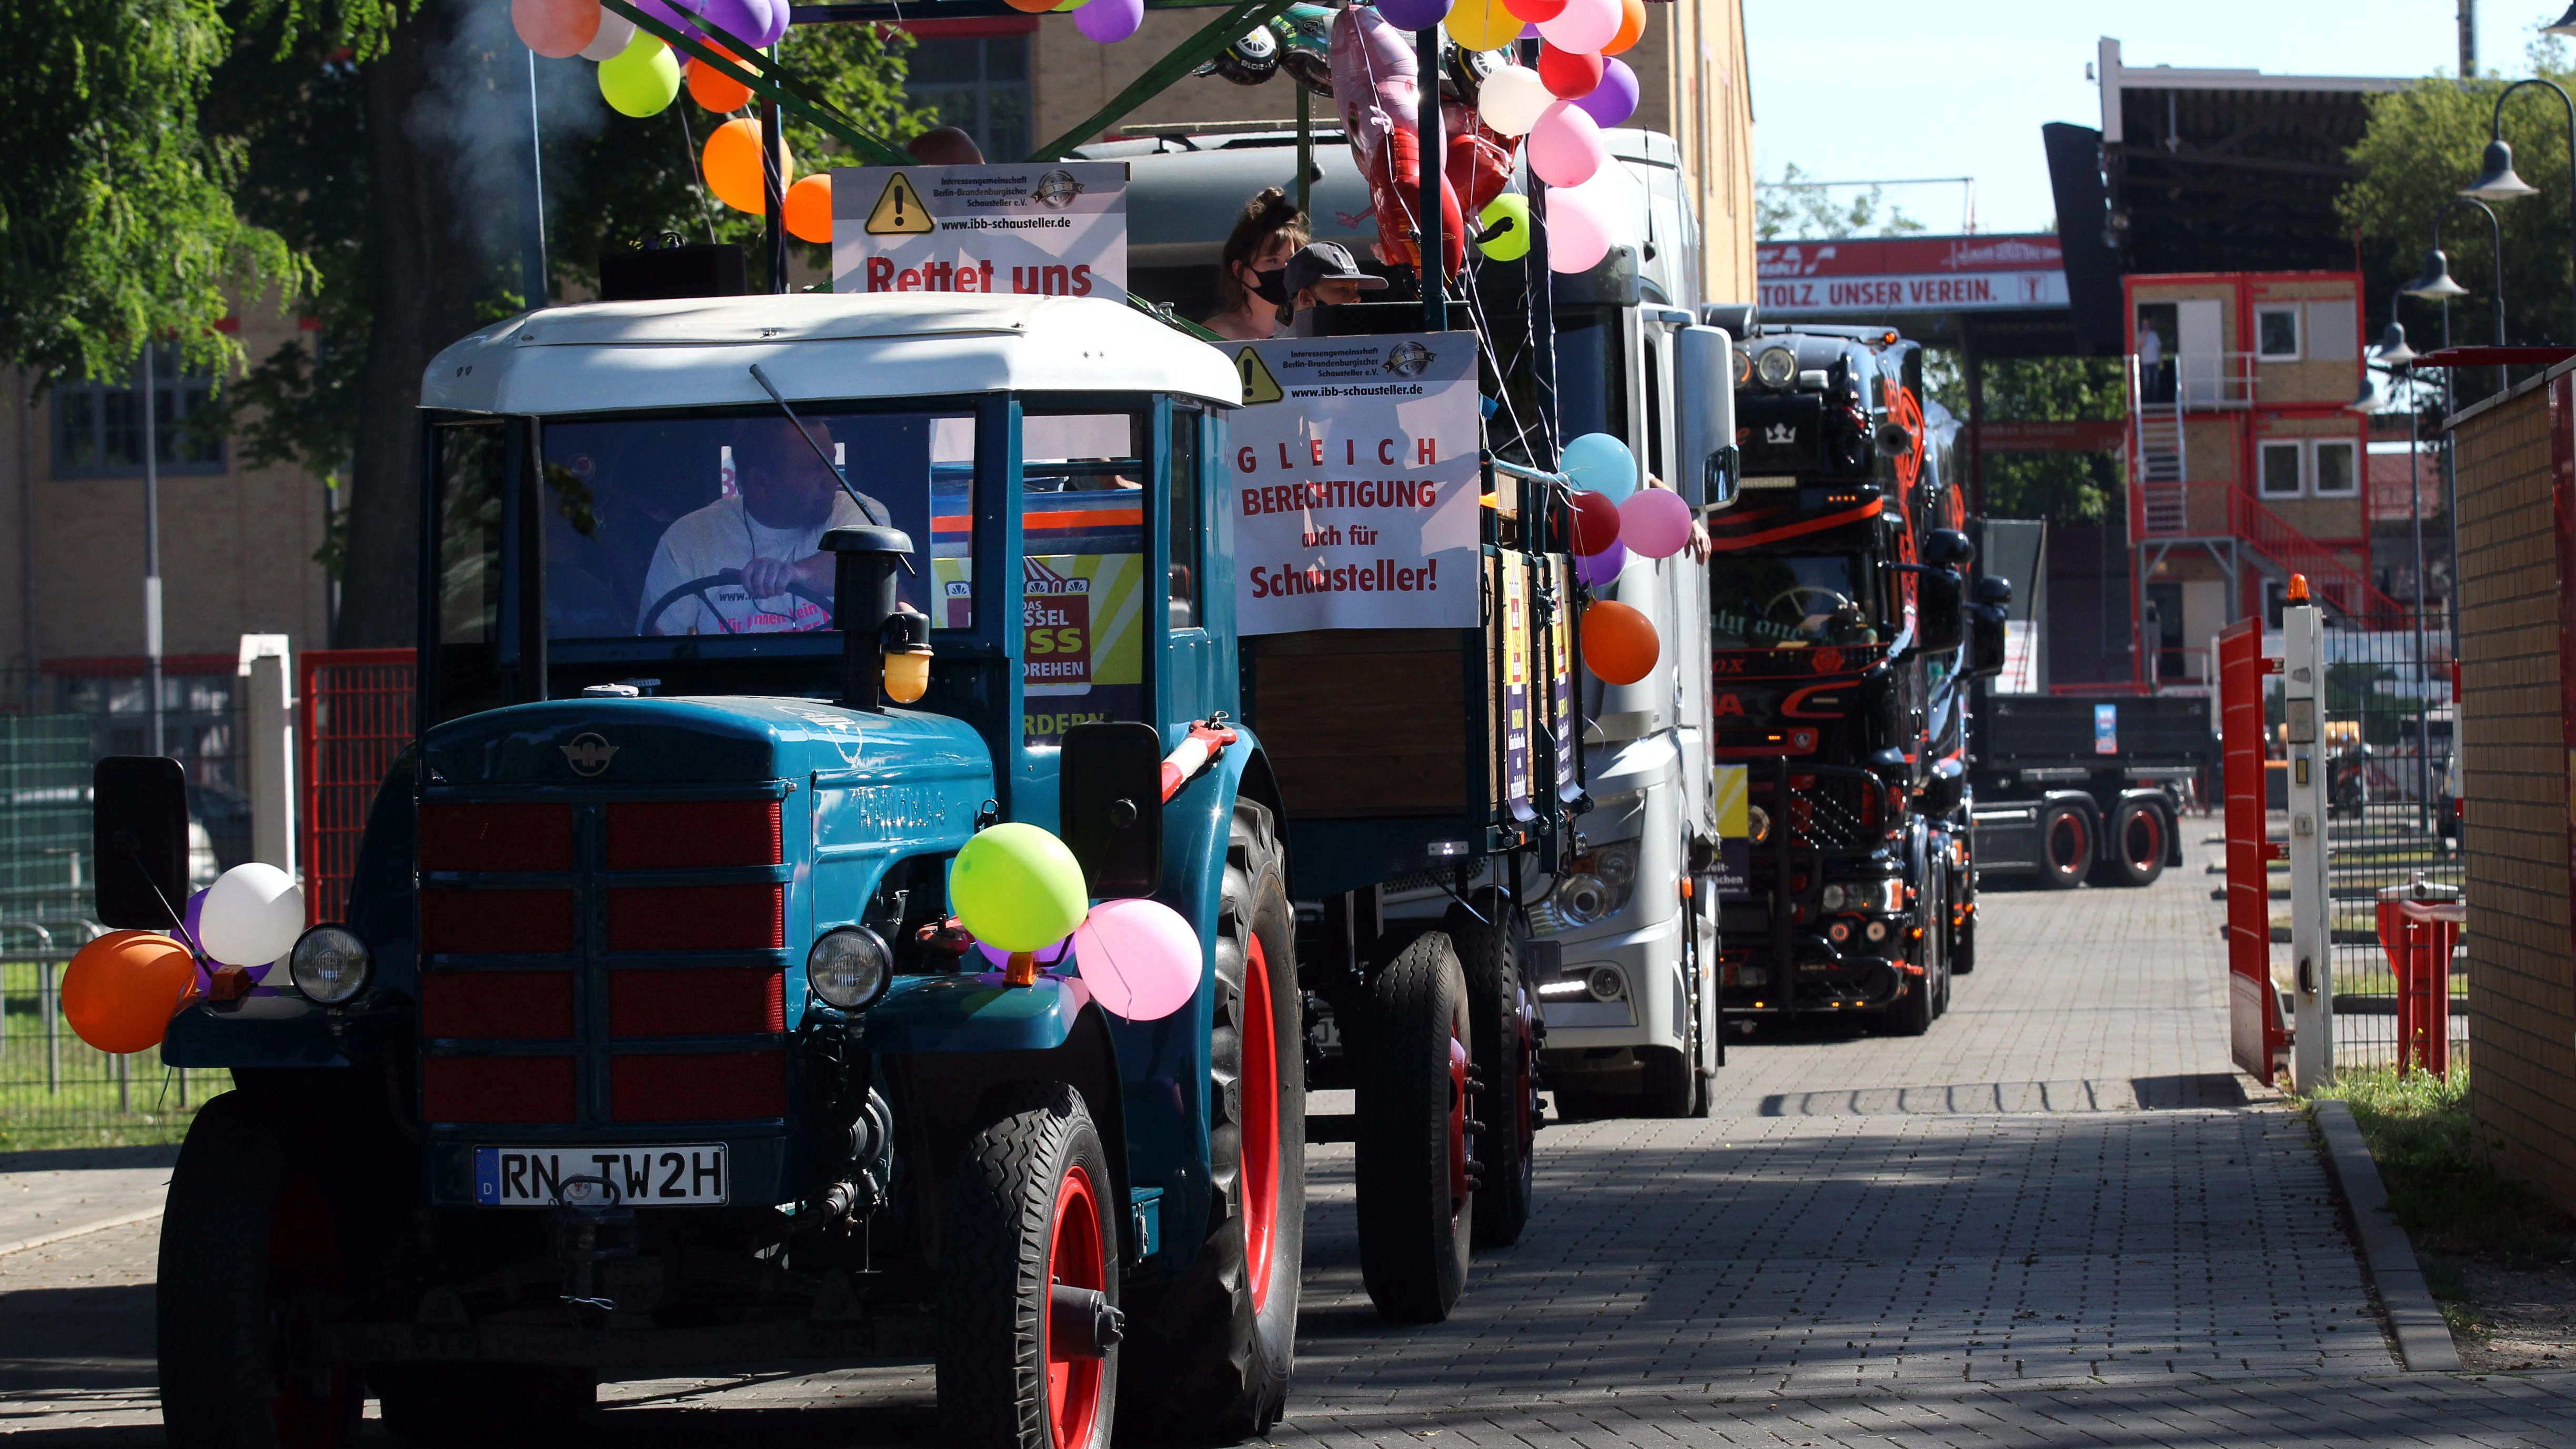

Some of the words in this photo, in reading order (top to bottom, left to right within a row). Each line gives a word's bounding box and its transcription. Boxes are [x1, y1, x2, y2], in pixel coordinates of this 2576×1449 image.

[941, 176, 1027, 186] Interessengemeinschaft
[933, 188, 1027, 197] Berlin-Brandenburgischer
[942, 217, 1071, 230] www.ibb-schausteller.de
[867, 257, 993, 293] Rettet
[1013, 264, 1092, 296] uns
[1758, 284, 1819, 307] TOLZ.
[1829, 281, 1902, 305] UNSER
[1909, 278, 1997, 303] VEREIN.
[1291, 348, 1378, 358] Interessengemeinschaft
[1283, 358, 1378, 368] Berlin-Brandenburgischer
[1291, 384, 1423, 397] www.ibb-schausteller.de
[1242, 480, 1436, 516] BERECHTIGUNG
[1302, 525, 1341, 547] auch
[1349, 525, 1378, 545] für
[1250, 559, 1436, 598] Schausteller!
[483, 1183, 492, 1195] D
